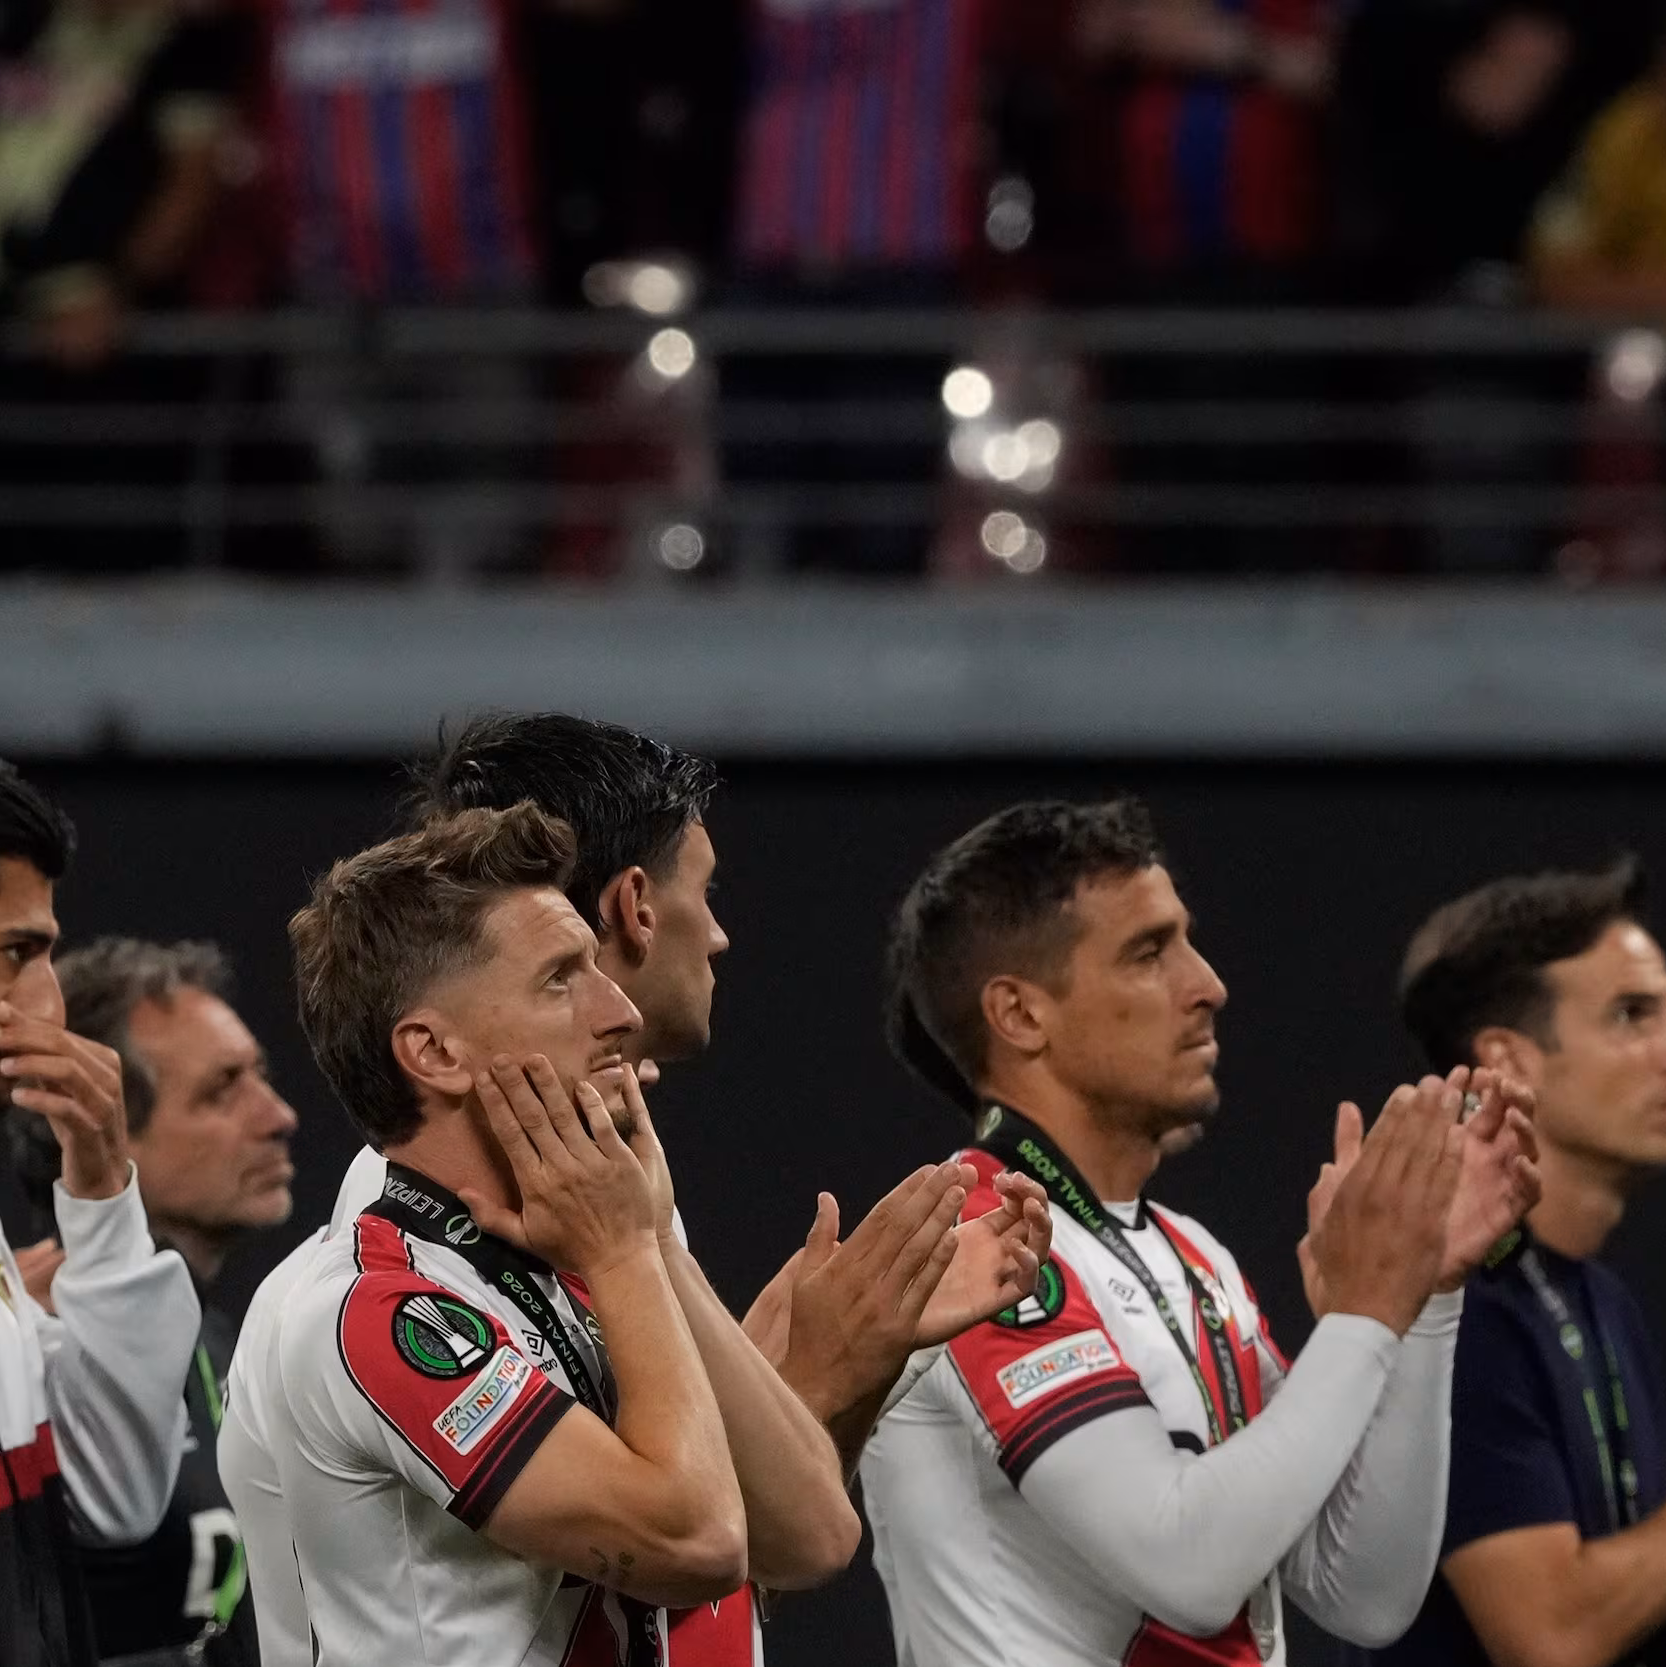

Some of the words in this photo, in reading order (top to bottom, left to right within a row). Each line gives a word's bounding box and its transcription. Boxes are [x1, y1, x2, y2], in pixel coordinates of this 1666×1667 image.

[384, 1177, 445, 1220] LEIPZ
[1060, 1176, 1103, 1231] FINAL
[501, 1271, 543, 1315] 2026
[546, 1315, 580, 1376] FINAL
[438, 1404, 463, 1431] UEFA
[445, 1350, 521, 1442] FOUNDATION
